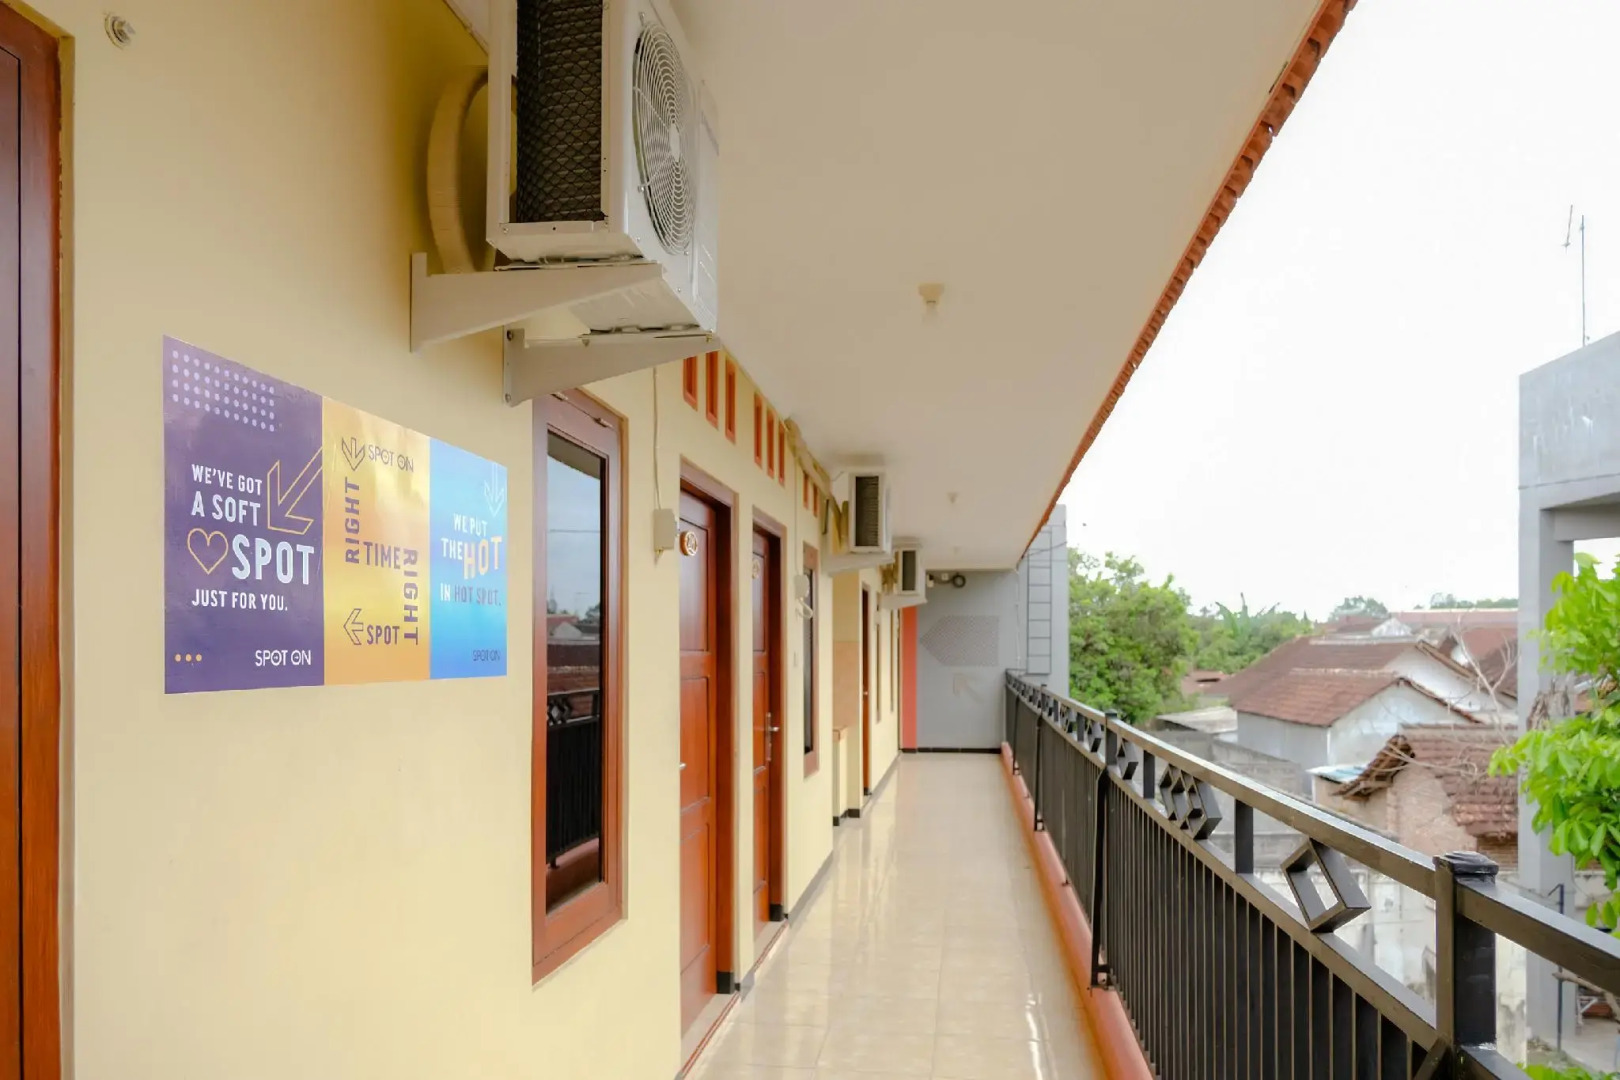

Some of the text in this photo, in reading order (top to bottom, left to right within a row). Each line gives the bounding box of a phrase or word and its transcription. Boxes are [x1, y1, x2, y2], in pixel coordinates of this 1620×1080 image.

[368, 444, 414, 472] SPOT ON
[192, 464, 262, 495] WE'VE GOT
[191, 491, 261, 526] A SOFT
[344, 477, 360, 564] RIGHT
[454, 513, 487, 537] WE PUT
[232, 534, 314, 585] SPOT
[363, 541, 401, 570] TIME
[441, 536, 502, 580] THE HOT
[192, 589, 288, 611] JUST FOR YOU.
[403, 550, 418, 645] RIGHT
[440, 583, 501, 606] IN HOT SPOT.
[366, 625, 400, 645] SPOT
[255, 650, 311, 667] SPOT ON
